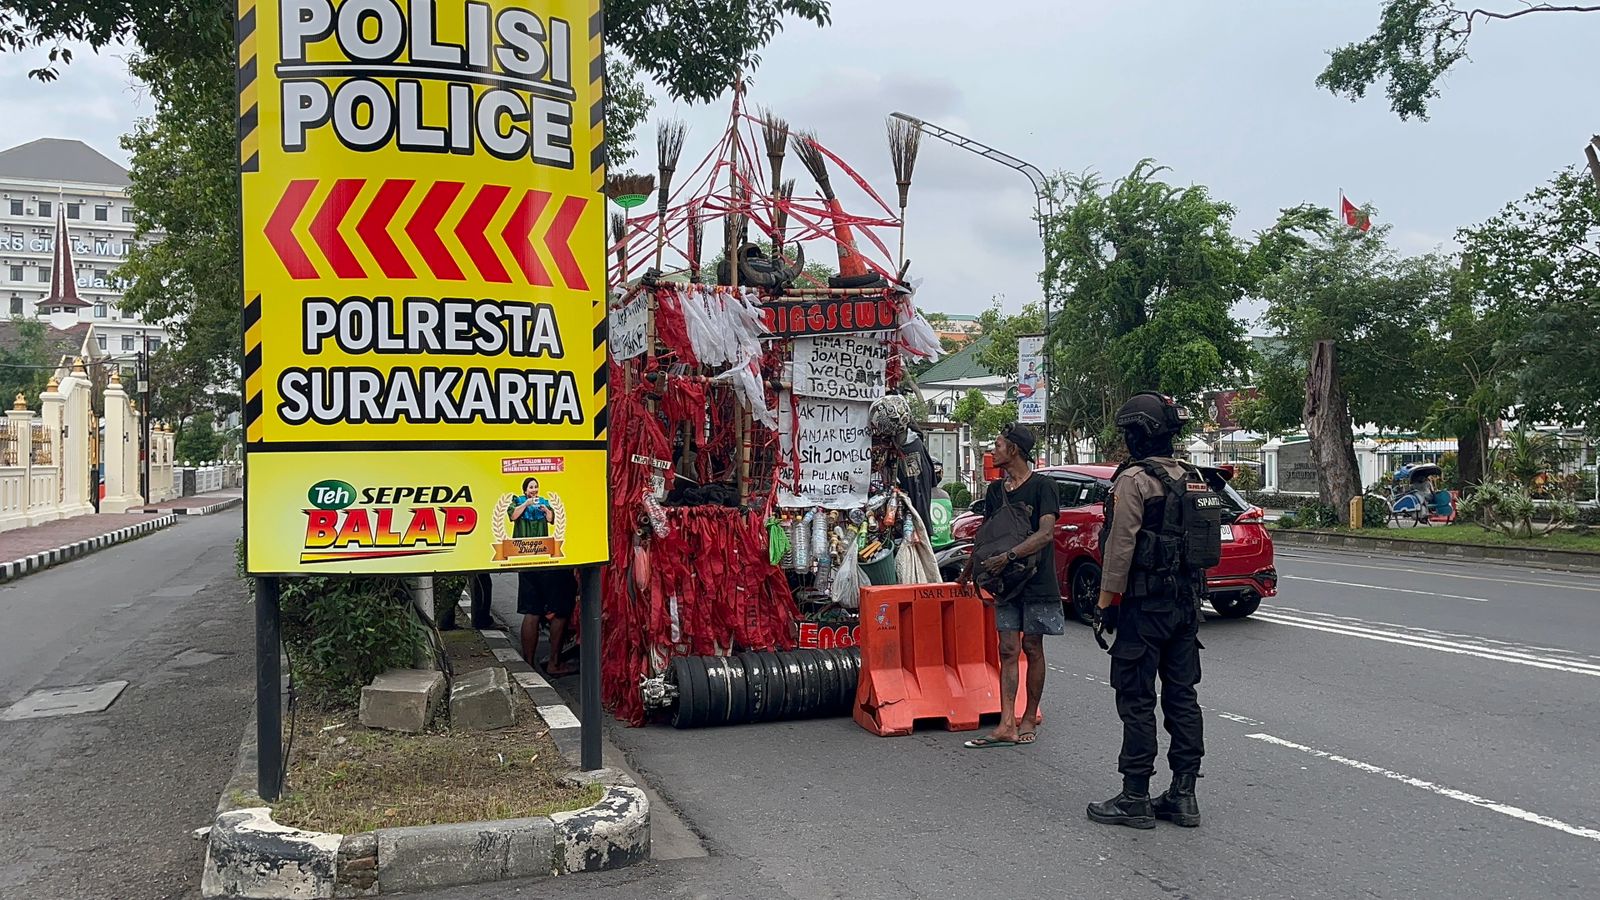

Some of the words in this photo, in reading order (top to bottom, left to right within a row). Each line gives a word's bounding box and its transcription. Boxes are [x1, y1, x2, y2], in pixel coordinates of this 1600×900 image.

[279, 0, 570, 85] POLISI
[282, 77, 574, 168] POLICE
[302, 297, 564, 358] POLRESTA
[277, 366, 585, 426] SURAKARTA
[816, 404, 849, 424] TIM
[315, 487, 350, 504] Teh
[358, 485, 474, 505] SEPEDA
[301, 506, 478, 550] BALAP
